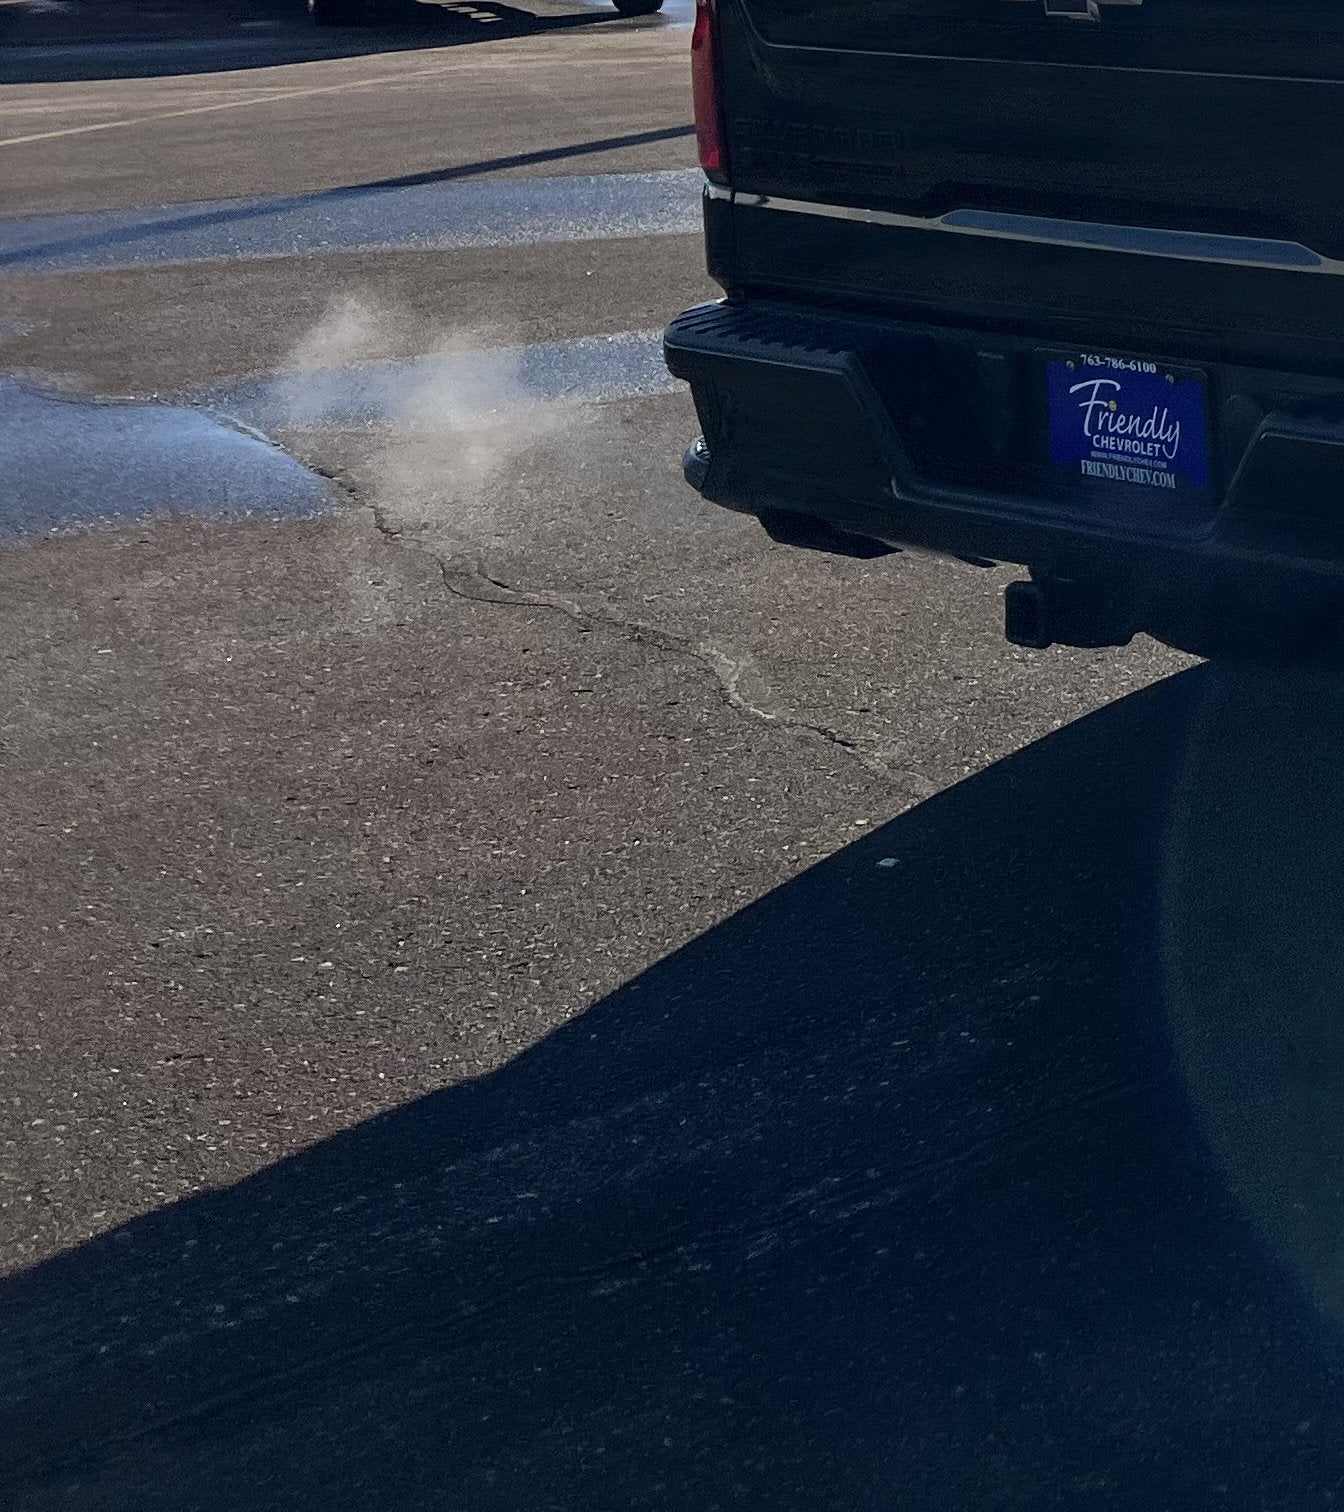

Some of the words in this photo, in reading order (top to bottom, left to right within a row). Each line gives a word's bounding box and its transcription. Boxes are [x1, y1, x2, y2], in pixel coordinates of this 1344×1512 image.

[1080, 353, 1157, 374] 763-786-6100
[1069, 378, 1180, 460] Friendly
[1092, 434, 1162, 458] CHEVROLET
[1080, 459, 1177, 489] FRIENDLYCHEV.COM
